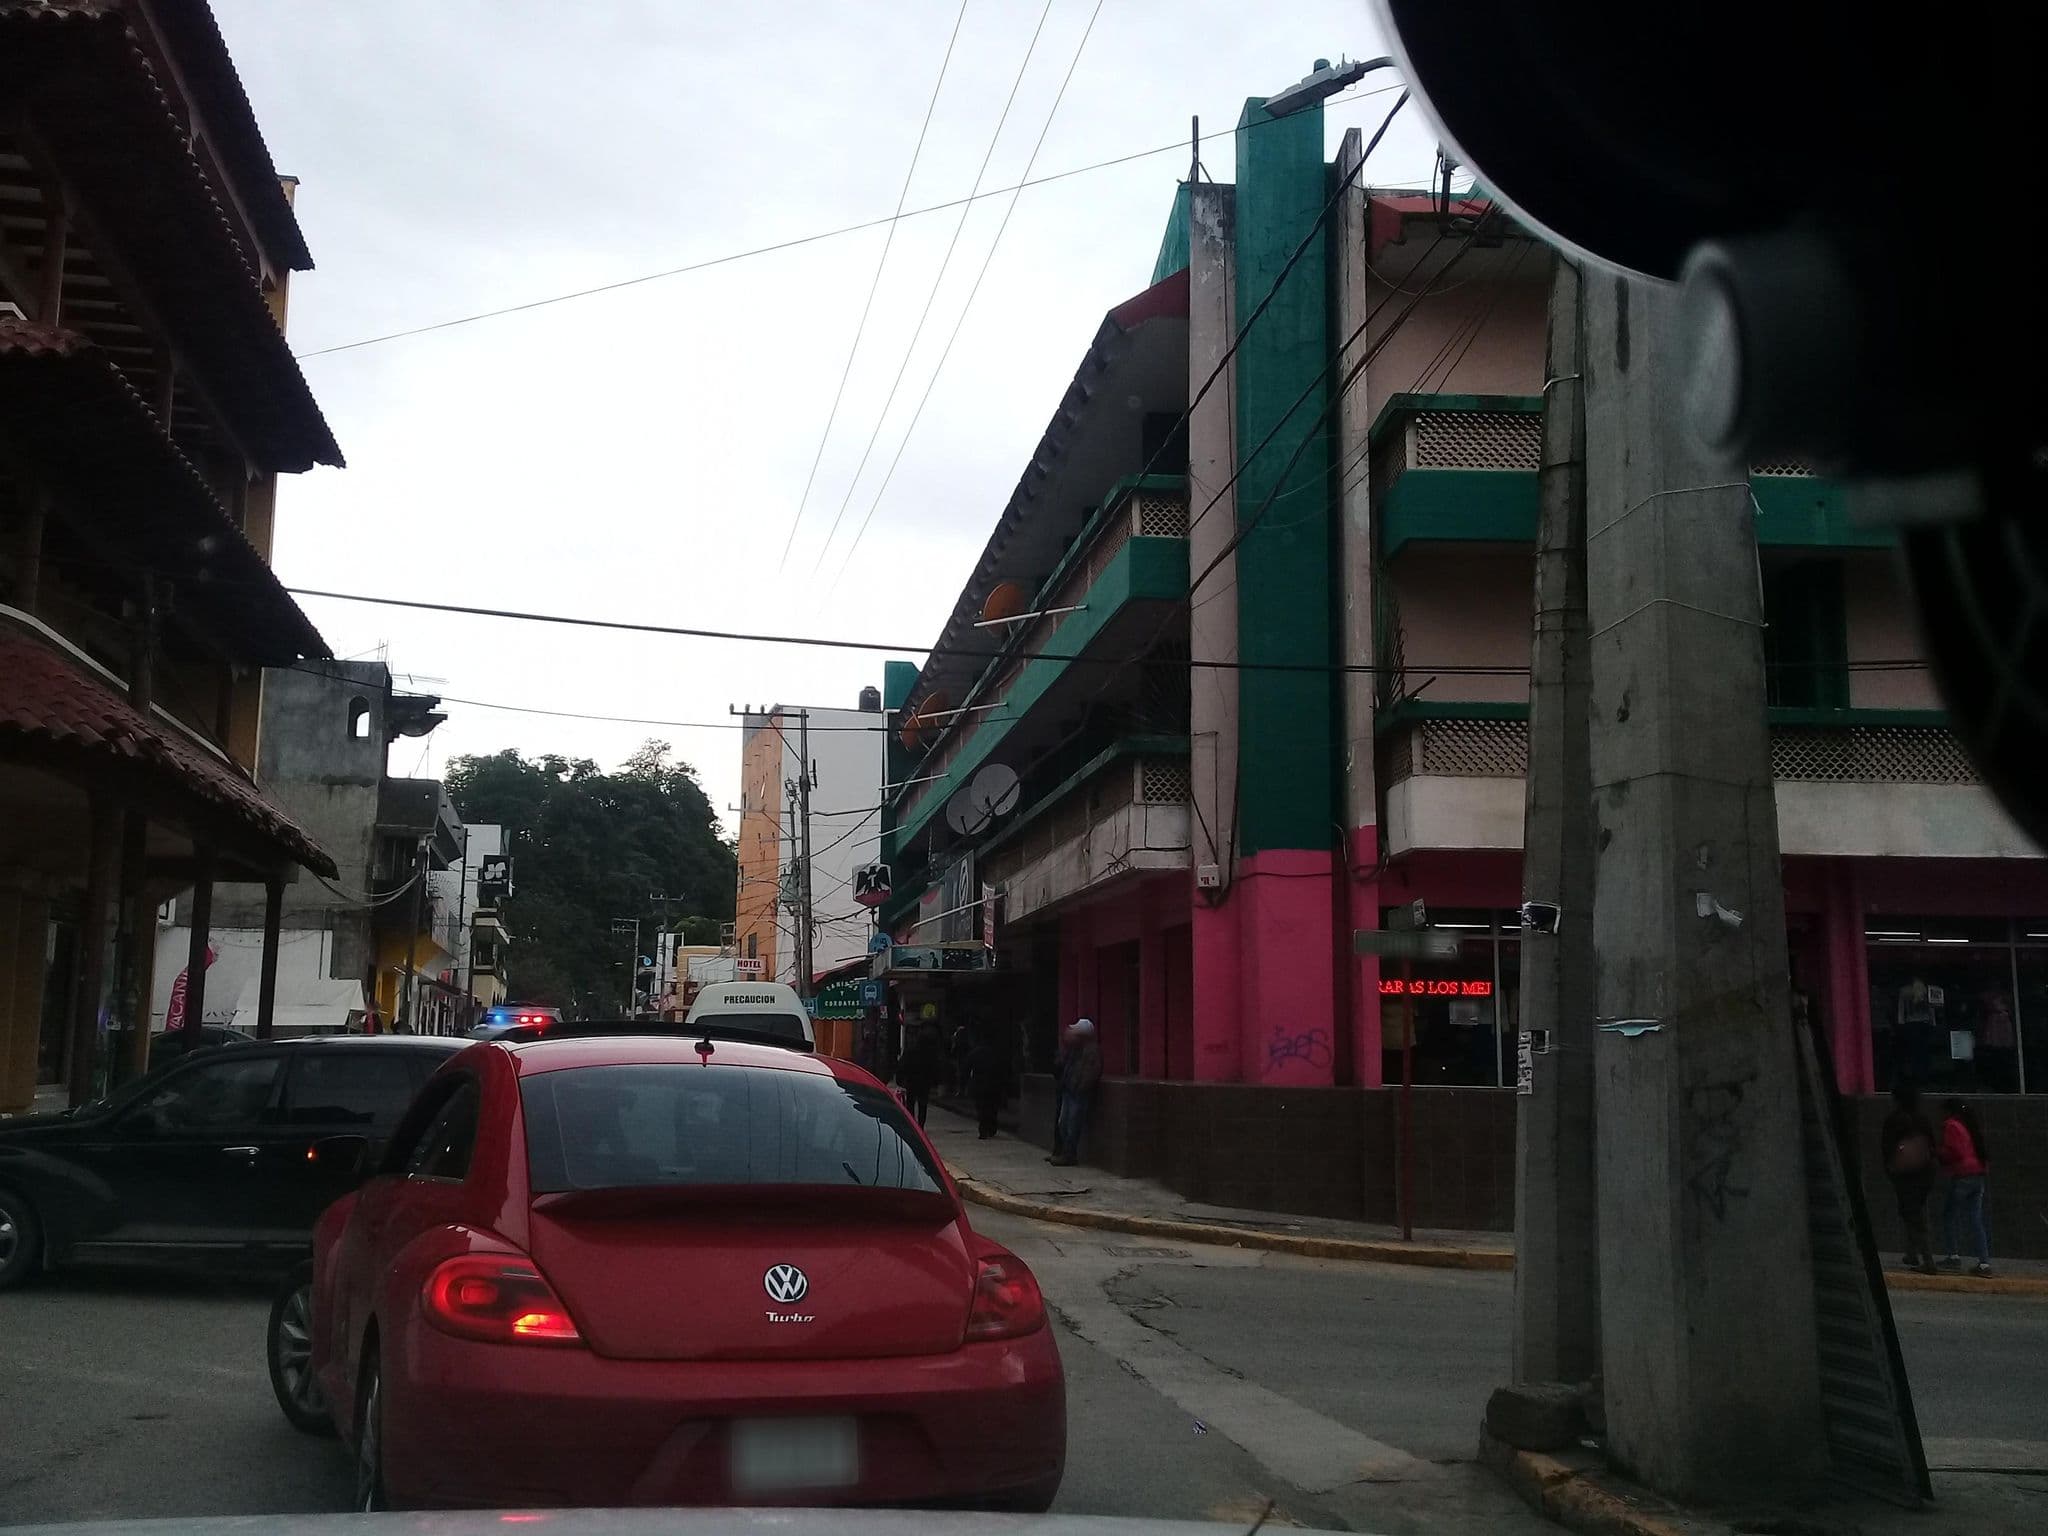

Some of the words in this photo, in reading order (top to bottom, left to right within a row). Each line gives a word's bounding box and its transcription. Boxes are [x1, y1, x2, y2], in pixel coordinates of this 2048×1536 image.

[737, 959, 762, 969] HOTEL
[1427, 980, 1458, 995] LOS
[723, 995, 776, 1004] PRECAUCION
[766, 1265, 805, 1301] VW
[765, 1311, 816, 1323] Turbo
